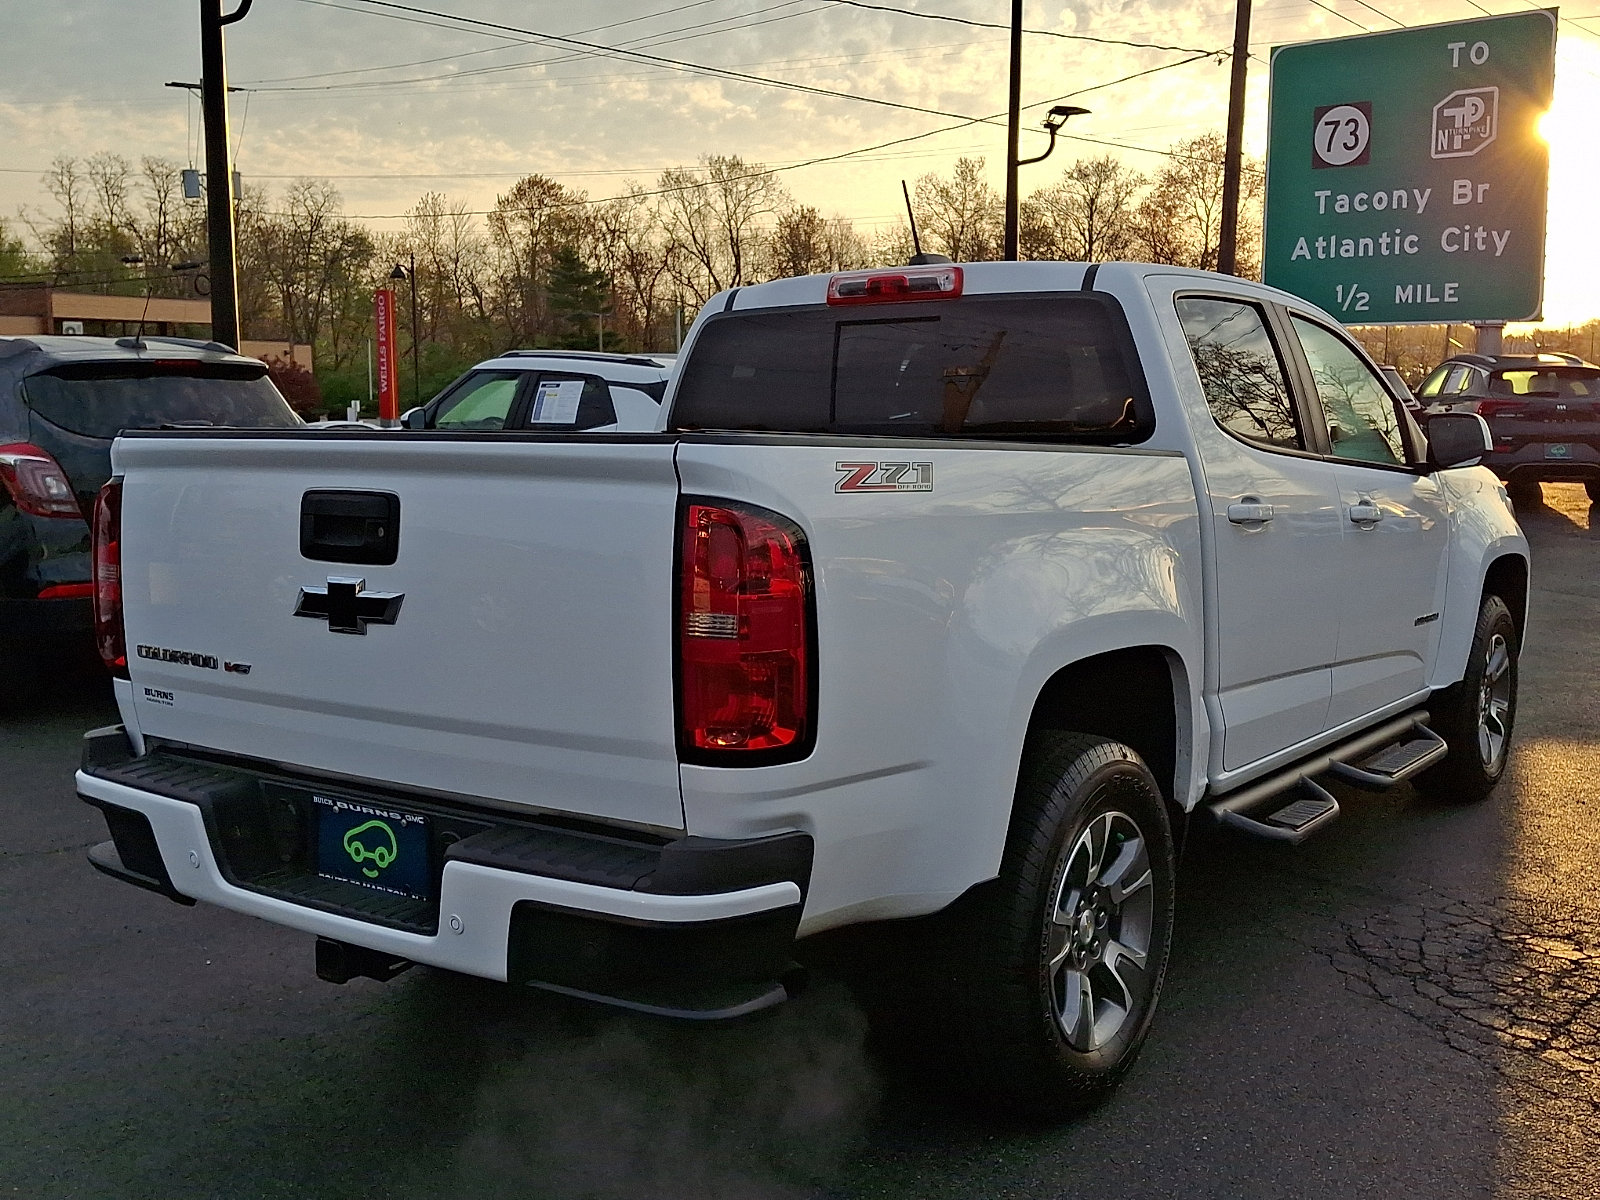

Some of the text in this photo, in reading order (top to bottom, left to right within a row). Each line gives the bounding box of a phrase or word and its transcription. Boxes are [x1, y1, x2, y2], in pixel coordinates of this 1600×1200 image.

[1447, 41, 1490, 68] TO
[1324, 117, 1360, 153] 73
[1314, 179, 1490, 215] Tacony Br
[1290, 224, 1511, 261] Atlantic City
[1335, 282, 1459, 312] 1/2 MILE
[378, 295, 388, 393] WELLS FARGO
[835, 462, 933, 494] Z71
[137, 644, 218, 670] COLORADO
[144, 687, 174, 701] BURNS
[313, 795, 425, 825] BUICK BURNS GMC
